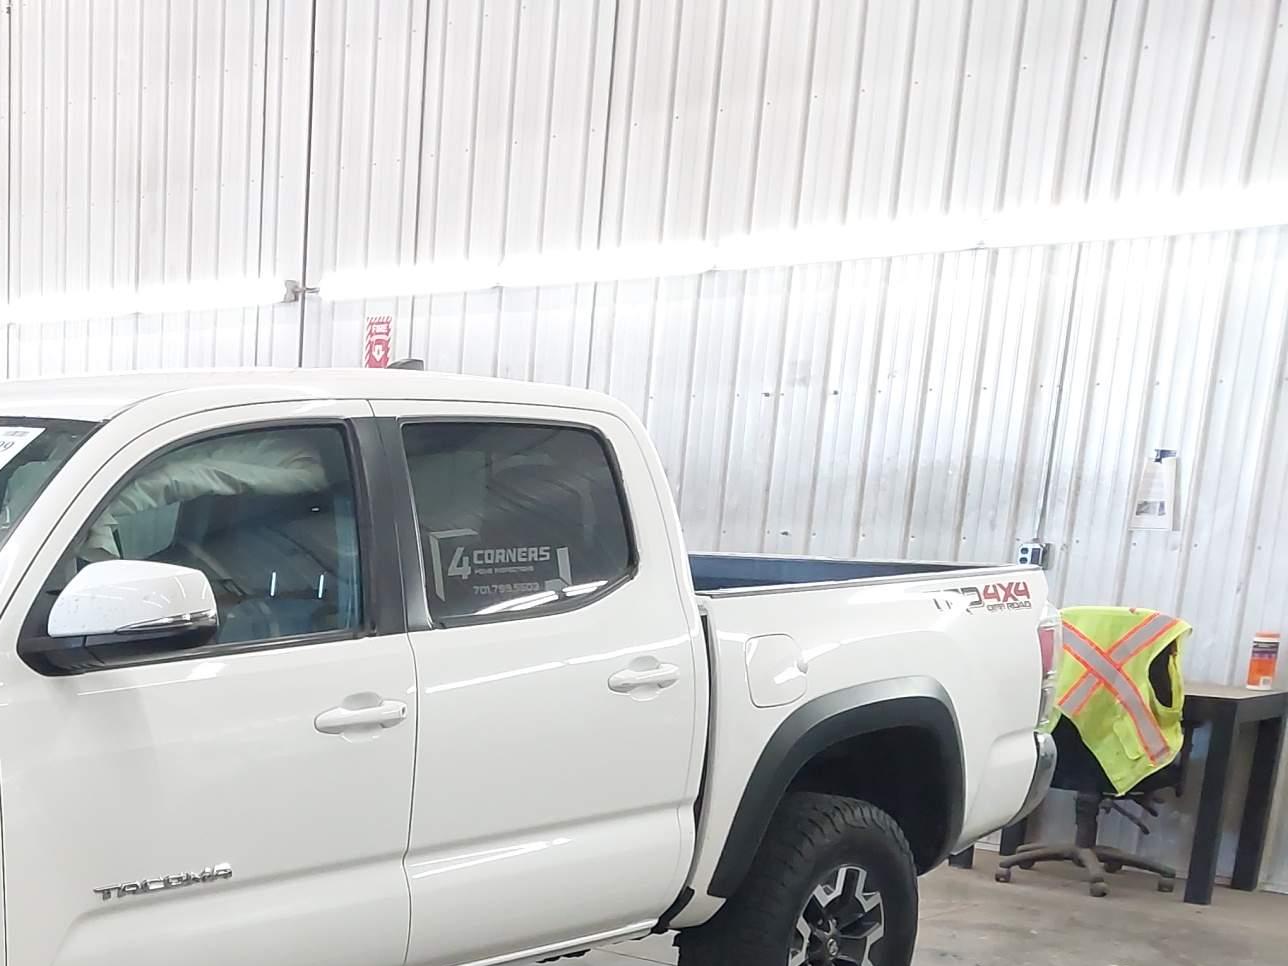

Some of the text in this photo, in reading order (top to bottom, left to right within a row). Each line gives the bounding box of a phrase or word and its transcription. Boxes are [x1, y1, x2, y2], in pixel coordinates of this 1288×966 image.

[448, 546, 551, 580] 4 CORNERS
[1006, 600, 1032, 610] ROAD
[93, 862, 233, 900] TACOMA
